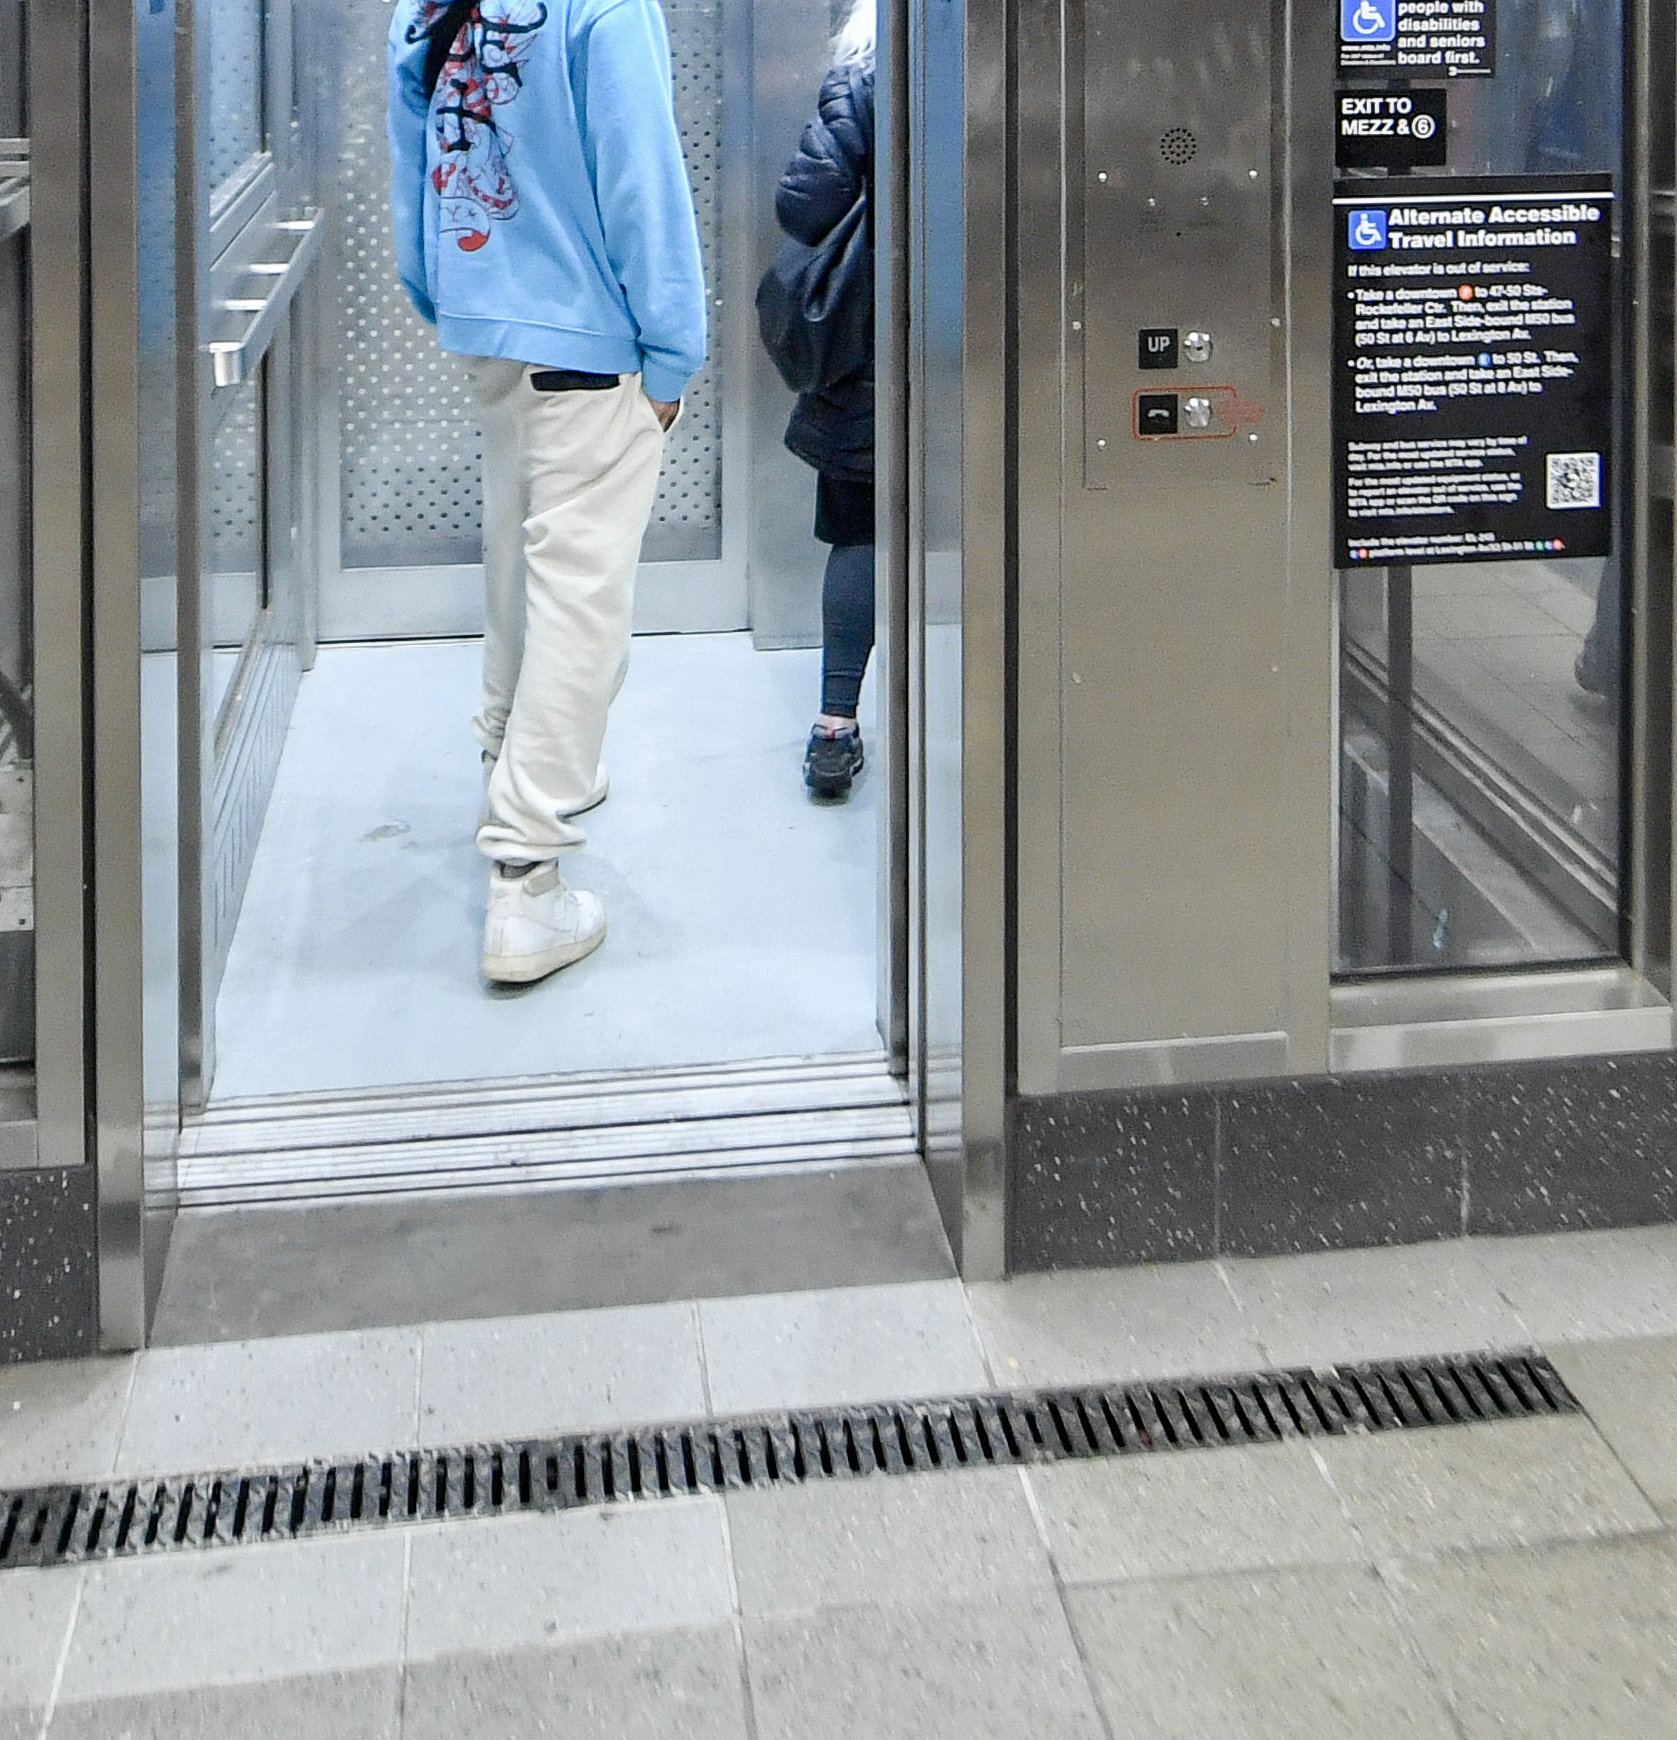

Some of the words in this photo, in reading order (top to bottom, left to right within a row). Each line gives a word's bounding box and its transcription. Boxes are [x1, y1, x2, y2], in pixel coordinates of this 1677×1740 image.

[1398, 0, 1449, 15] people
[1452, 0, 1484, 13] with
[1397, 18, 1480, 31] disabilities
[1397, 34, 1426, 48] and
[1430, 34, 1486, 48] seniors
[1398, 51, 1442, 65] board
[1445, 51, 1480, 64] first.
[1341, 98, 1383, 114] EXIT
[1387, 97, 1412, 113] TO
[1341, 119, 1393, 136] MEZZ
[1396, 120, 1410, 135] &
[1417, 120, 1428, 135] 6
[1388, 207, 1485, 226] Alternate
[1488, 204, 1601, 224] Accessible
[1388, 230, 1454, 250] Travel
[1457, 228, 1578, 248] Information
[1359, 265, 1381, 276] this
[1384, 264, 1431, 276] elevator
[1446, 263, 1466, 274] out
[1468, 262, 1481, 274] of
[1356, 289, 1384, 300] Take
[1396, 288, 1457, 300] downtown
[1475, 286, 1488, 297] to
[1356, 303, 1423, 315] Rockefeller
[1531, 298, 1572, 310] station
[1356, 318, 1379, 330] and
[1381, 318, 1406, 329] take
[1426, 317, 1452, 327] East
[1437, 331, 1450, 342] to
[1451, 330, 1510, 343] Lexington
[1147, 336, 1171, 352] UP
[1376, 356, 1401, 368] take
[1413, 355, 1475, 367] downtown
[1493, 354, 1505, 364] to
[1380, 371, 1399, 382] the
[1401, 370, 1442, 382] station
[1445, 369, 1467, 380] and
[1513, 366, 1540, 378] East
[1356, 386, 1394, 398] bound
[1529, 381, 1542, 392] to
[1356, 400, 1416, 414] Lexington
